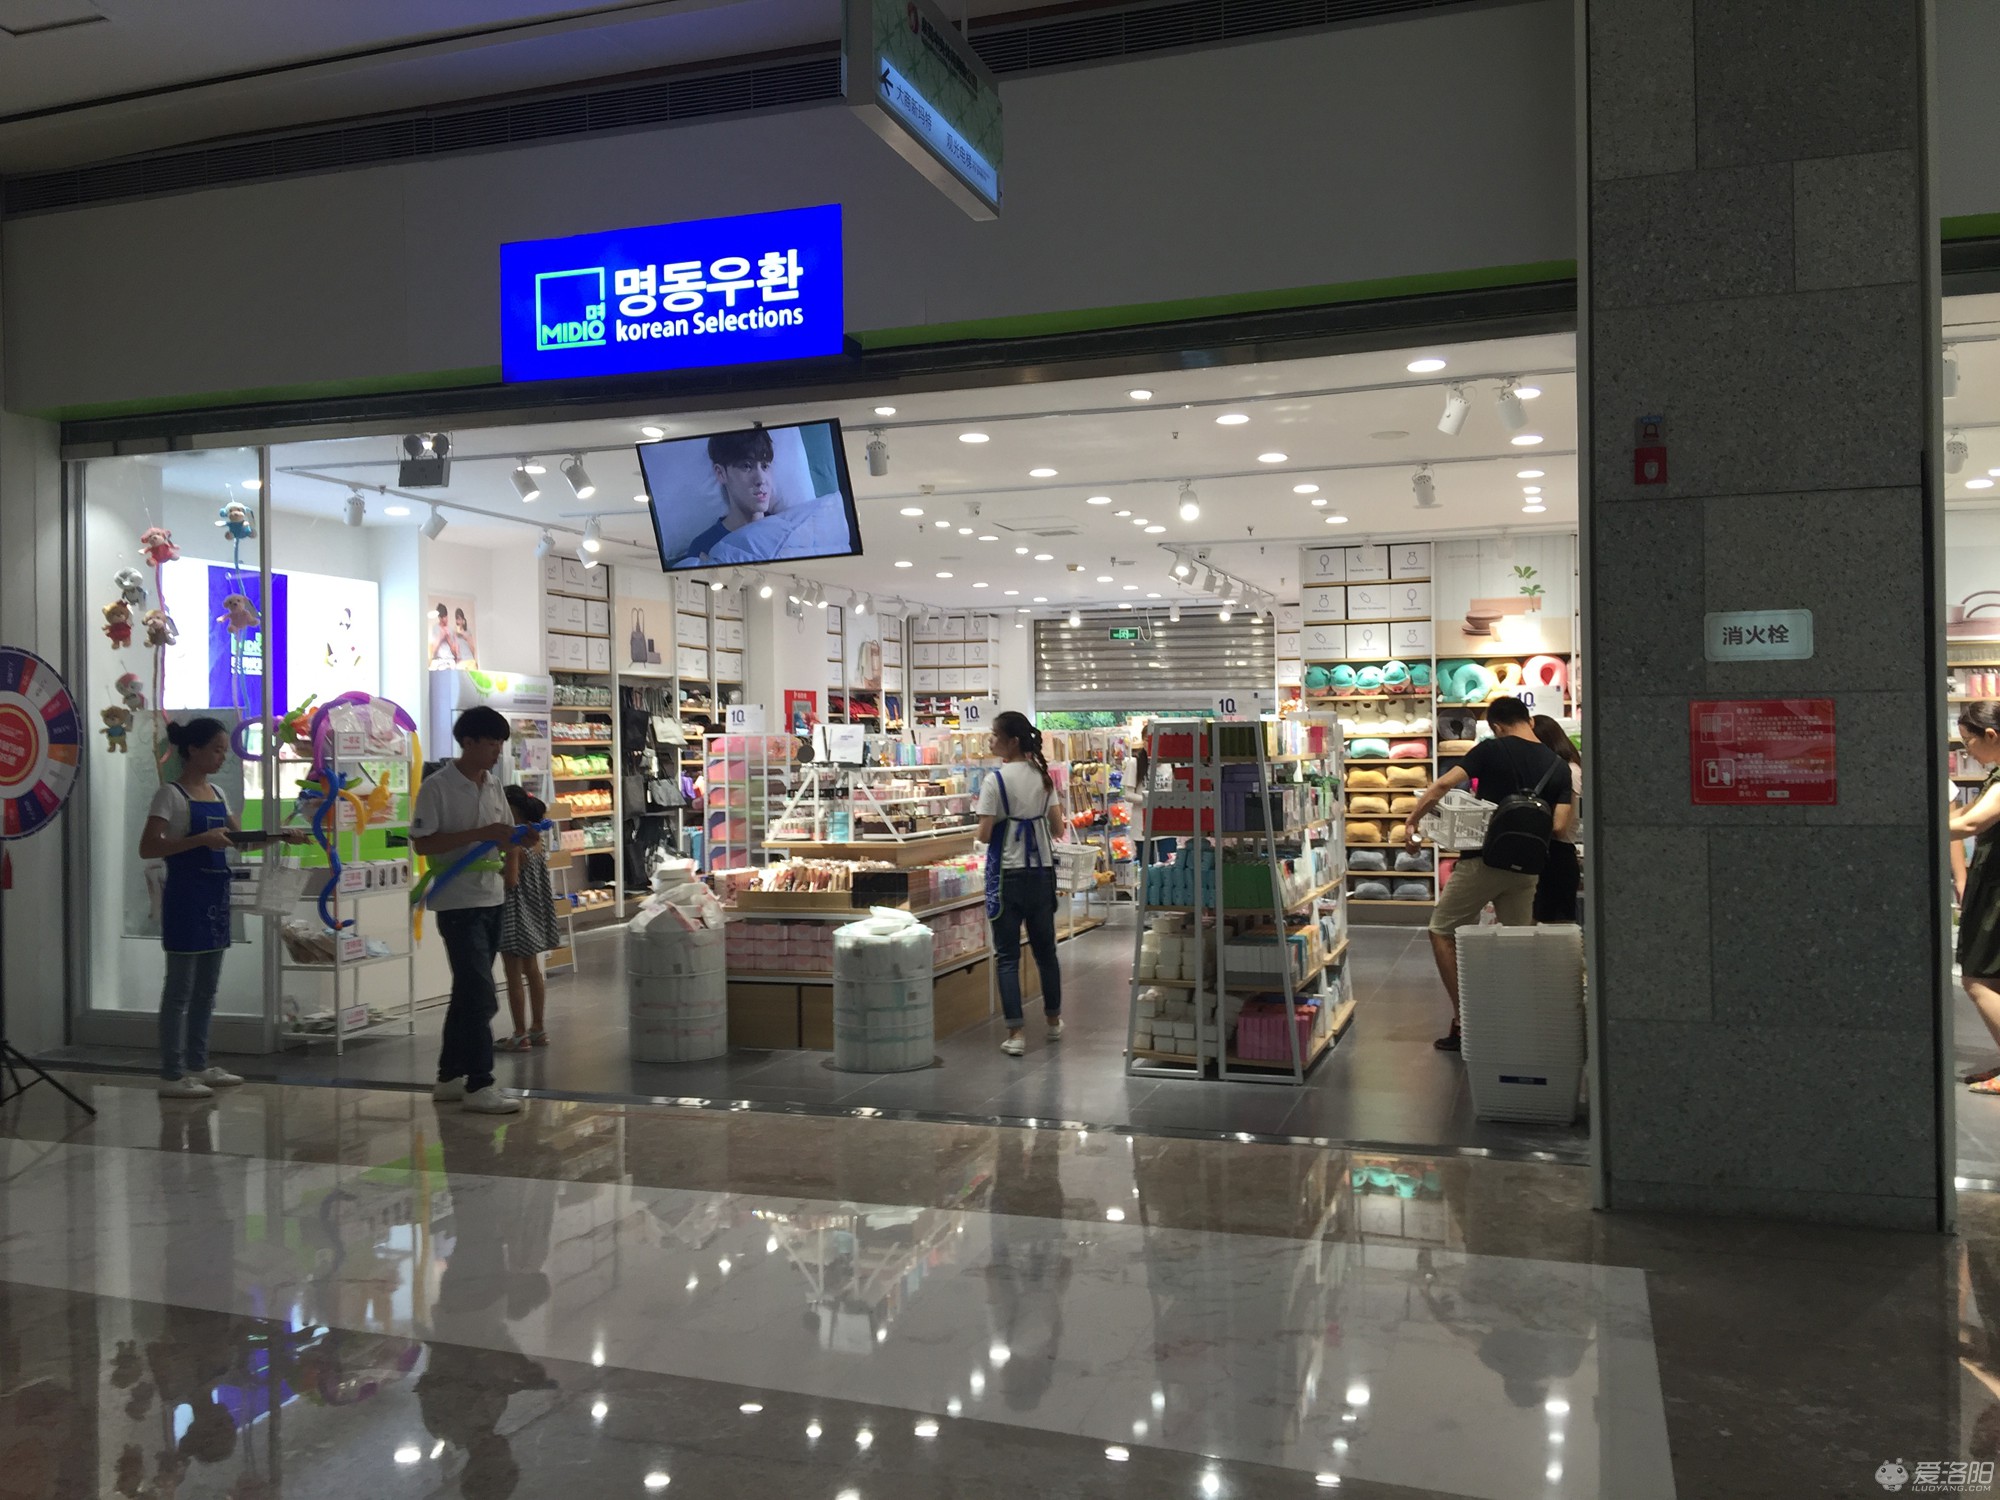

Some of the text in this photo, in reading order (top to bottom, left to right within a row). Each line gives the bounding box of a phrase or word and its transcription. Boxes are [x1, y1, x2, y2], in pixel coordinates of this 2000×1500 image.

[614, 249, 804, 317] 명동우환
[541, 319, 605, 344] MIDIO
[616, 306, 804, 342] korean Selections
[1722, 624, 1790, 646] 消火栓
